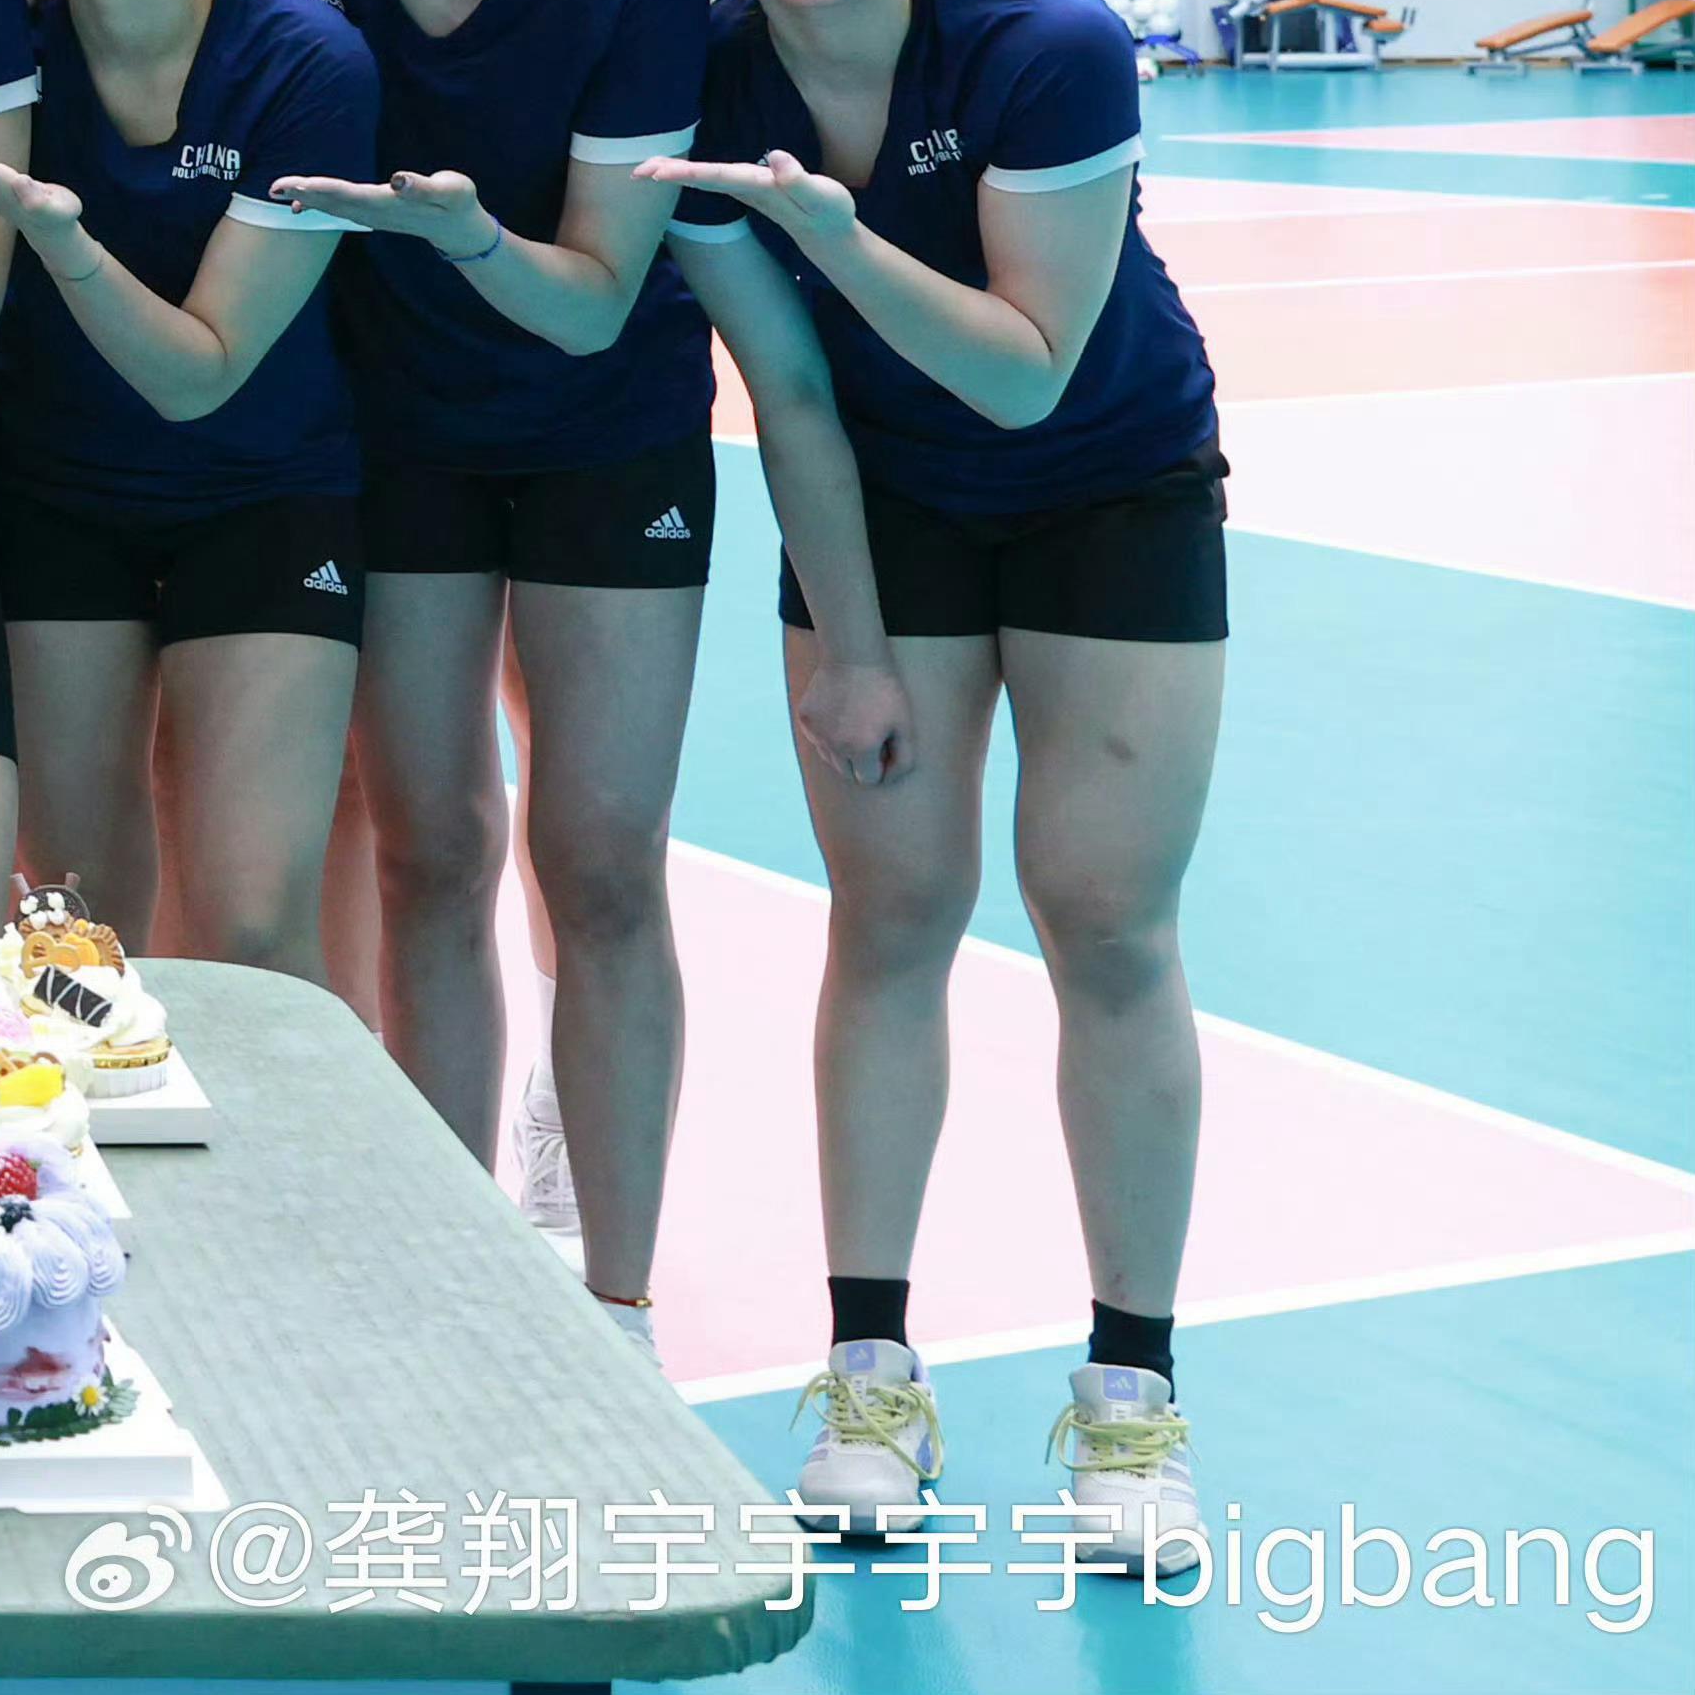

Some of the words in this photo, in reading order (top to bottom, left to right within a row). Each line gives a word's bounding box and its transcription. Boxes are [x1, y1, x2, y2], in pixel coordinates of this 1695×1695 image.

[180, 143, 241, 170] CHINA
[644, 526, 691, 539] adidas
[303, 577, 348, 595] adidas
